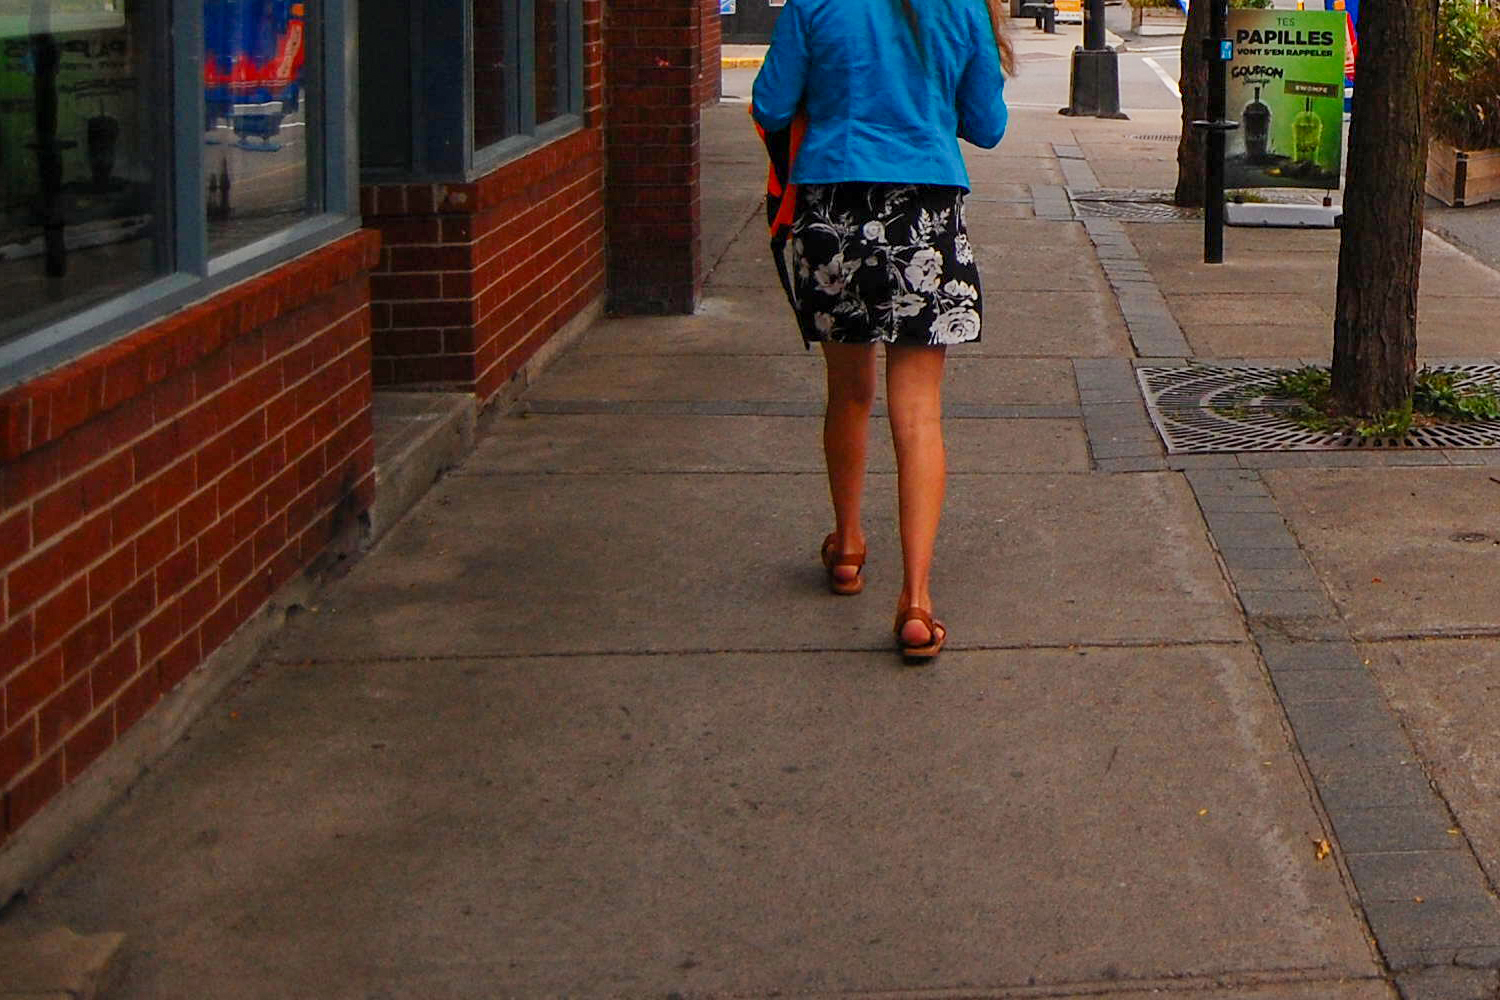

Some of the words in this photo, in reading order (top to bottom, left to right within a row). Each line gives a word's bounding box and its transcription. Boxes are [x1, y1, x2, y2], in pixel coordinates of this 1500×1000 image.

[1277, 17, 1295, 26] TES
[1236, 29, 1334, 46] PAPILLES
[1237, 48, 1262, 56] VONT
[1264, 48, 1285, 56] S'EN
[1286, 49, 1333, 57] RAPPELER
[1231, 65, 1284, 79] GOUDRON
